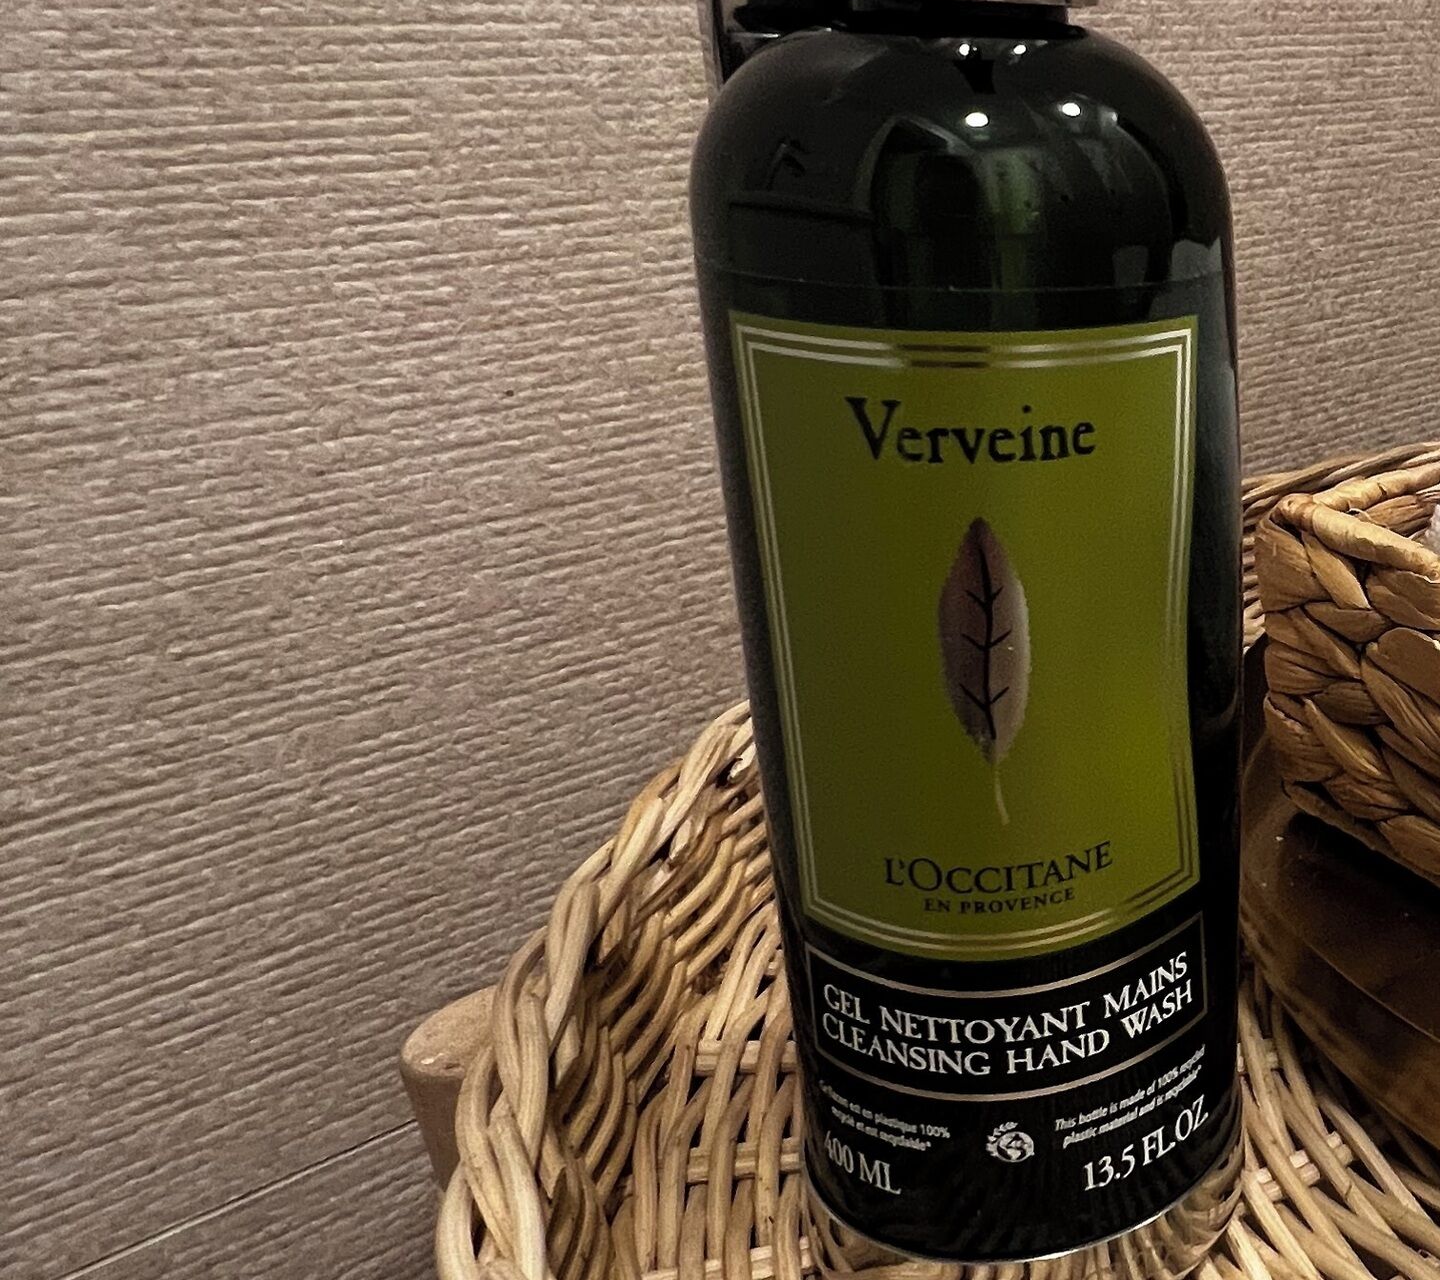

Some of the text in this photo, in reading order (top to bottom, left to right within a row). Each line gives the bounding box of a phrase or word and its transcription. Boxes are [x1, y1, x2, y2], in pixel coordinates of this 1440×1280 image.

[845, 396, 1097, 463] Verveine
[884, 840, 1113, 894] L'OCCITANE
[924, 888, 1075, 914] EN PROVENCE
[822, 979, 1192, 1076] CLEANSING HAND WASH
[824, 951, 1187, 1044] GEL NETTOYANT MAINS
[824, 1130, 901, 1194] 400 ML
[920, 1123, 950, 1138] 100%
[1084, 1144, 1136, 1191] 13.5
[1175, 1094, 1209, 1141] OZ
